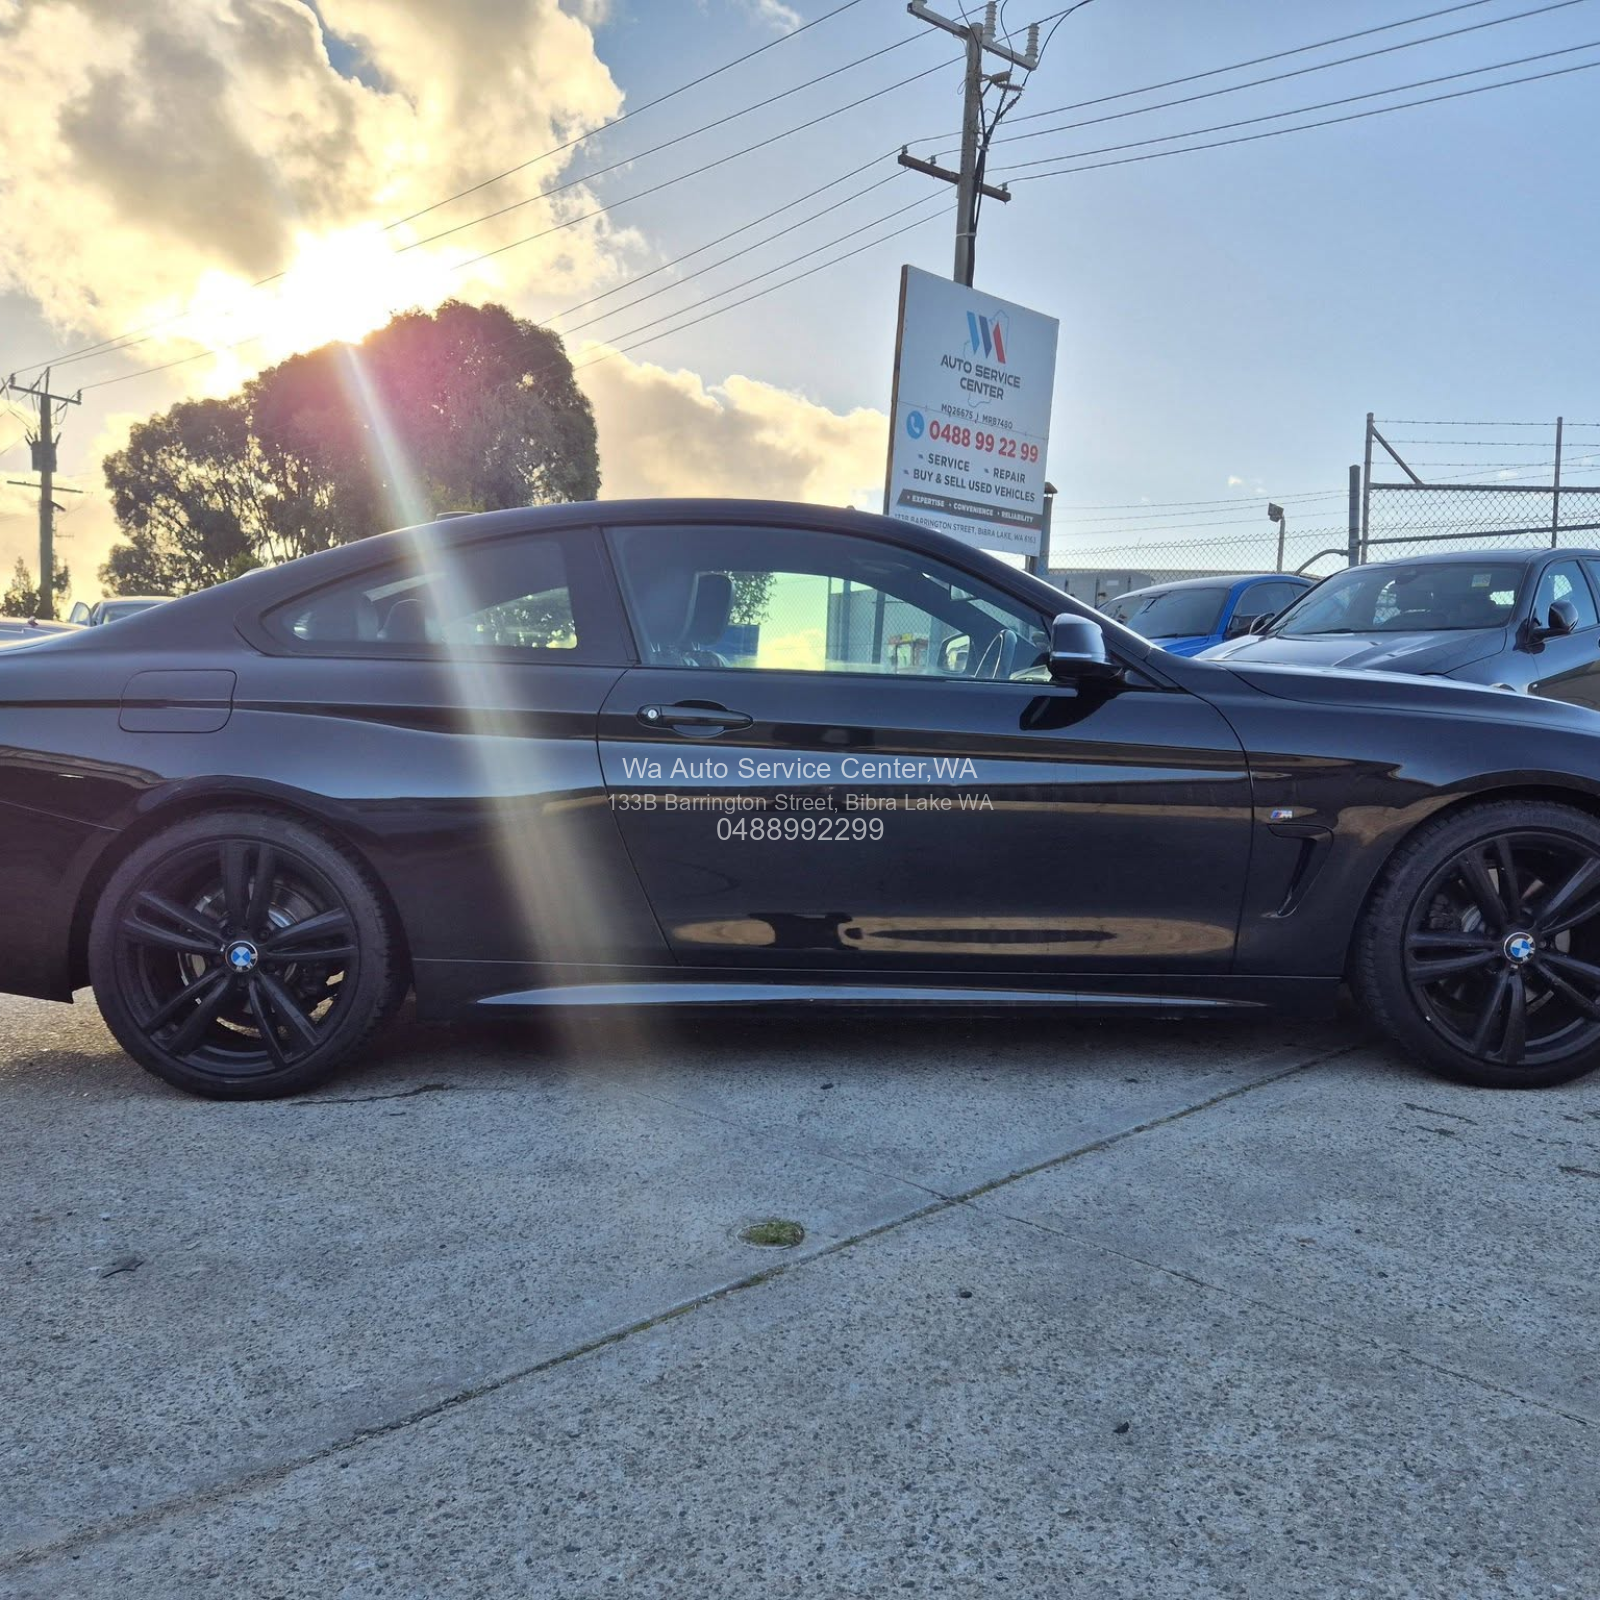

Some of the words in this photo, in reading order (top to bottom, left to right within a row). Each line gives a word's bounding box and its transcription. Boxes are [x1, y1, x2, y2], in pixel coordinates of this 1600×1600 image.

[940, 354, 972, 374] AUTO
[975, 364, 1021, 389] SERVICE
[959, 377, 1004, 400] CENTER
[929, 420, 971, 448] 0488
[975, 431, 995, 453] 99
[998, 437, 1017, 459] 22
[1020, 442, 1039, 463] 99
[928, 453, 970, 472] SERVICE
[993, 467, 1026, 484] REPAIR
[913, 468, 934, 482] BUY
[935, 473, 942, 484] &
[944, 475, 966, 489] SELL
[968, 480, 993, 494] USED
[994, 485, 1036, 503] VEHICLES
[912, 495, 945, 508] EXPERTISE
[953, 502, 994, 516] CONVENIENCE
[1001, 511, 1034, 523] RELIABILITY
